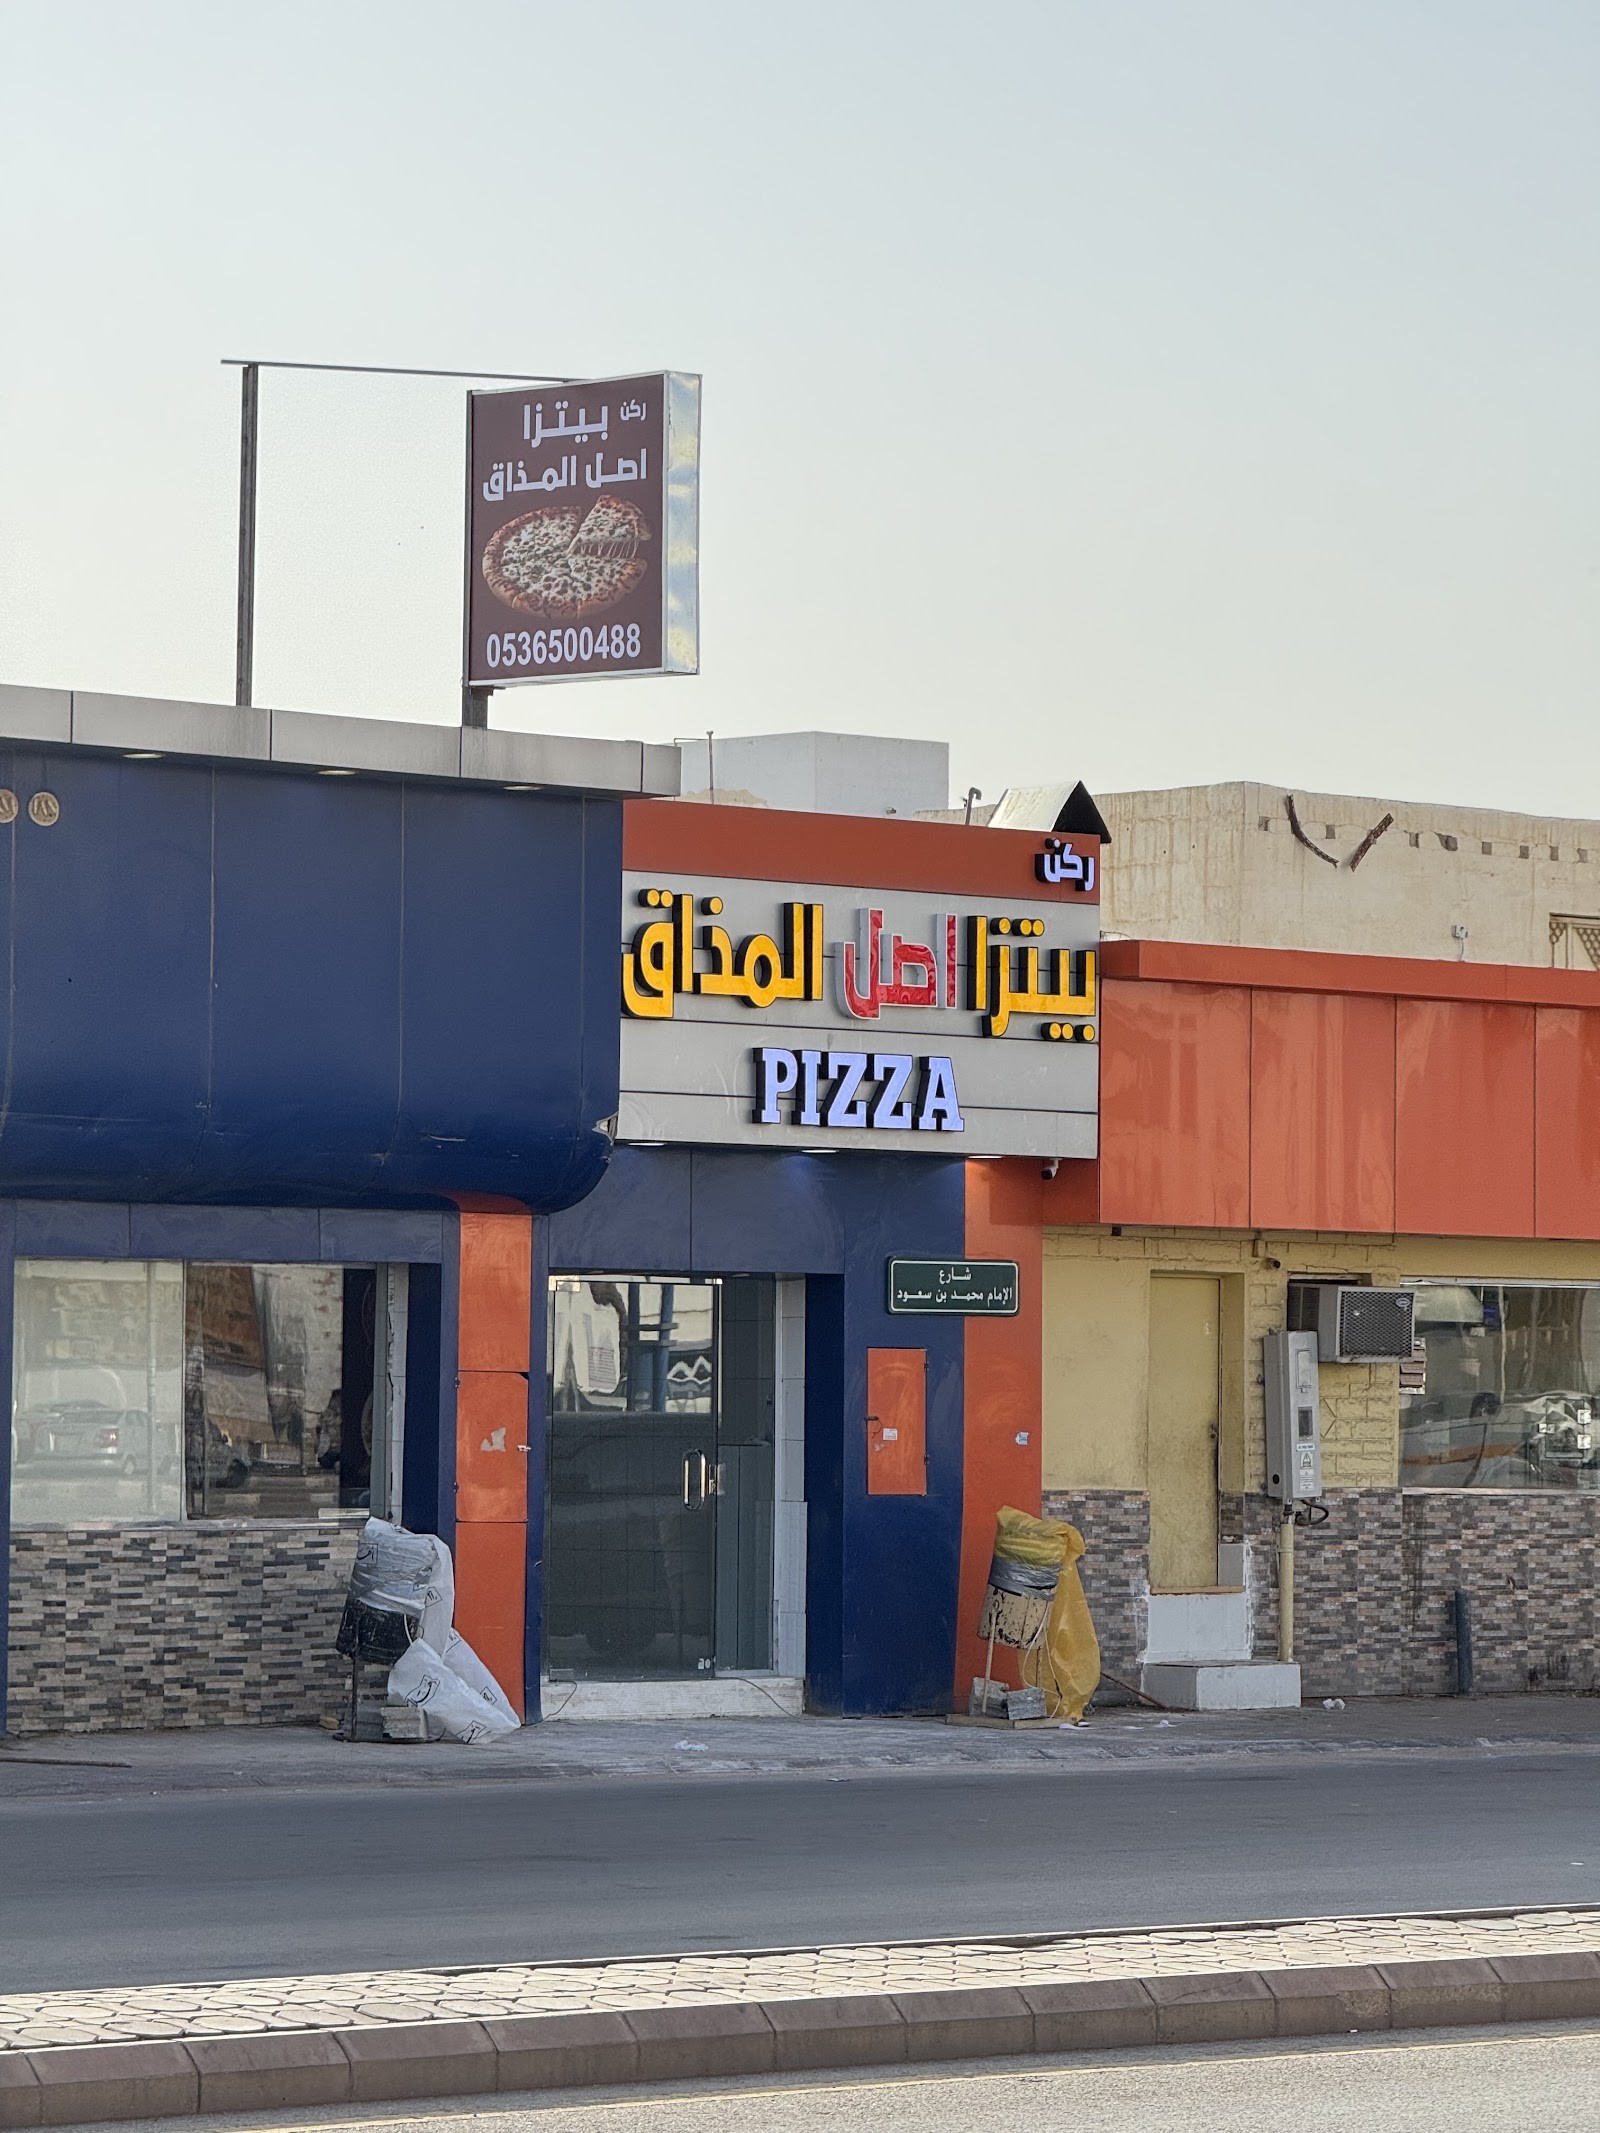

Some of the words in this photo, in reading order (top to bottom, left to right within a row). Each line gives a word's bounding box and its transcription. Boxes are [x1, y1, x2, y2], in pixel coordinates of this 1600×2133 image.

[523, 400, 608, 448] بيتزا
[620, 399, 647, 421] ركن
[482, 454, 577, 501] المذاق
[585, 448, 647, 489] اصل
[486, 623, 641, 668] 0536500488
[1035, 837, 1095, 891] ركن
[621, 888, 824, 1019] المذاق
[835, 907, 958, 1019] اصل
[967, 914, 1096, 1042] بيتزا
[752, 1046, 965, 1132] PIZZA
[897, 1288, 932, 1302] سعود
[935, 1288, 947, 1302] بن
[939, 1266, 972, 1284] شارع
[951, 1287, 984, 1300] محمد
[987, 1286, 1013, 1307] الإمام
